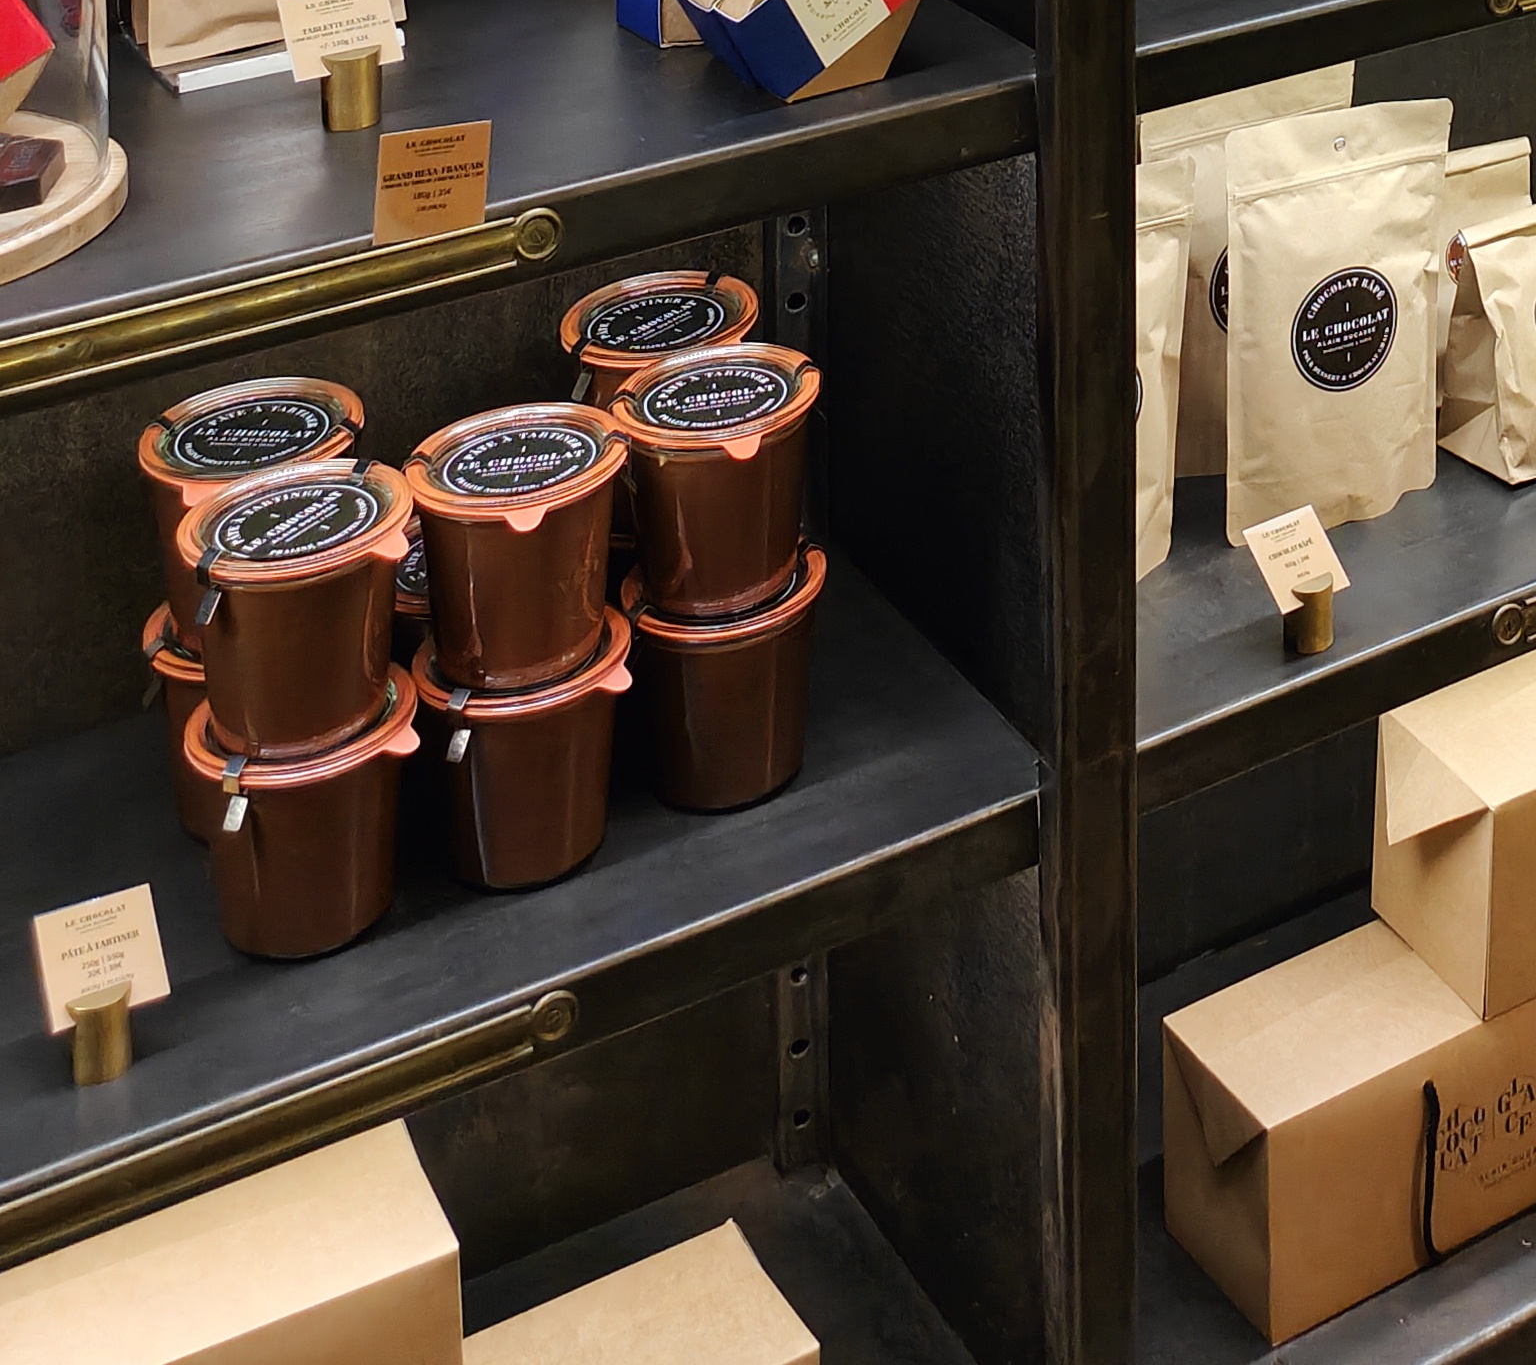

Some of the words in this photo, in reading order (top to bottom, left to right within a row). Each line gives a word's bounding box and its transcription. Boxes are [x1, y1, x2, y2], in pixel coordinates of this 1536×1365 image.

[302, 20, 344, 35] TABLETTE
[821, 33, 832, 43] LE
[420, 134, 465, 146] CHOCOLAT
[383, 172, 412, 183] GRAND
[441, 161, 485, 174] FRANÇAIS
[613, 298, 682, 316] TARTINER
[1306, 277, 1359, 320] CHOCOLAT
[1361, 277, 1386, 301] RÂPÉ
[1302, 327, 1320, 342] LE
[1324, 307, 1390, 337] CHOCOLAT
[1316, 337, 1341, 348] ALAIN
[704, 370, 770, 384] TARTINER
[655, 398, 678, 409] LE
[684, 383, 776, 404] CHOCOLAT
[271, 404, 319, 429] TARTINER
[194, 427, 218, 436] LE
[223, 427, 316, 439] CHOCOLAT
[519, 431, 584, 449] TARTINER
[457, 460, 481, 470] LE
[488, 449, 586, 467] CHOCOLAT
[244, 490, 323, 517] TARTINER
[242, 537, 264, 552] LE
[266, 490, 343, 537] CHOCOLAT
[65, 919, 77, 928] LE
[79, 903, 126, 923] CHOCOLAT
[61, 946, 86, 961] PÂTE
[86, 942, 94, 954] À
[96, 929, 140, 951] TARTINER
